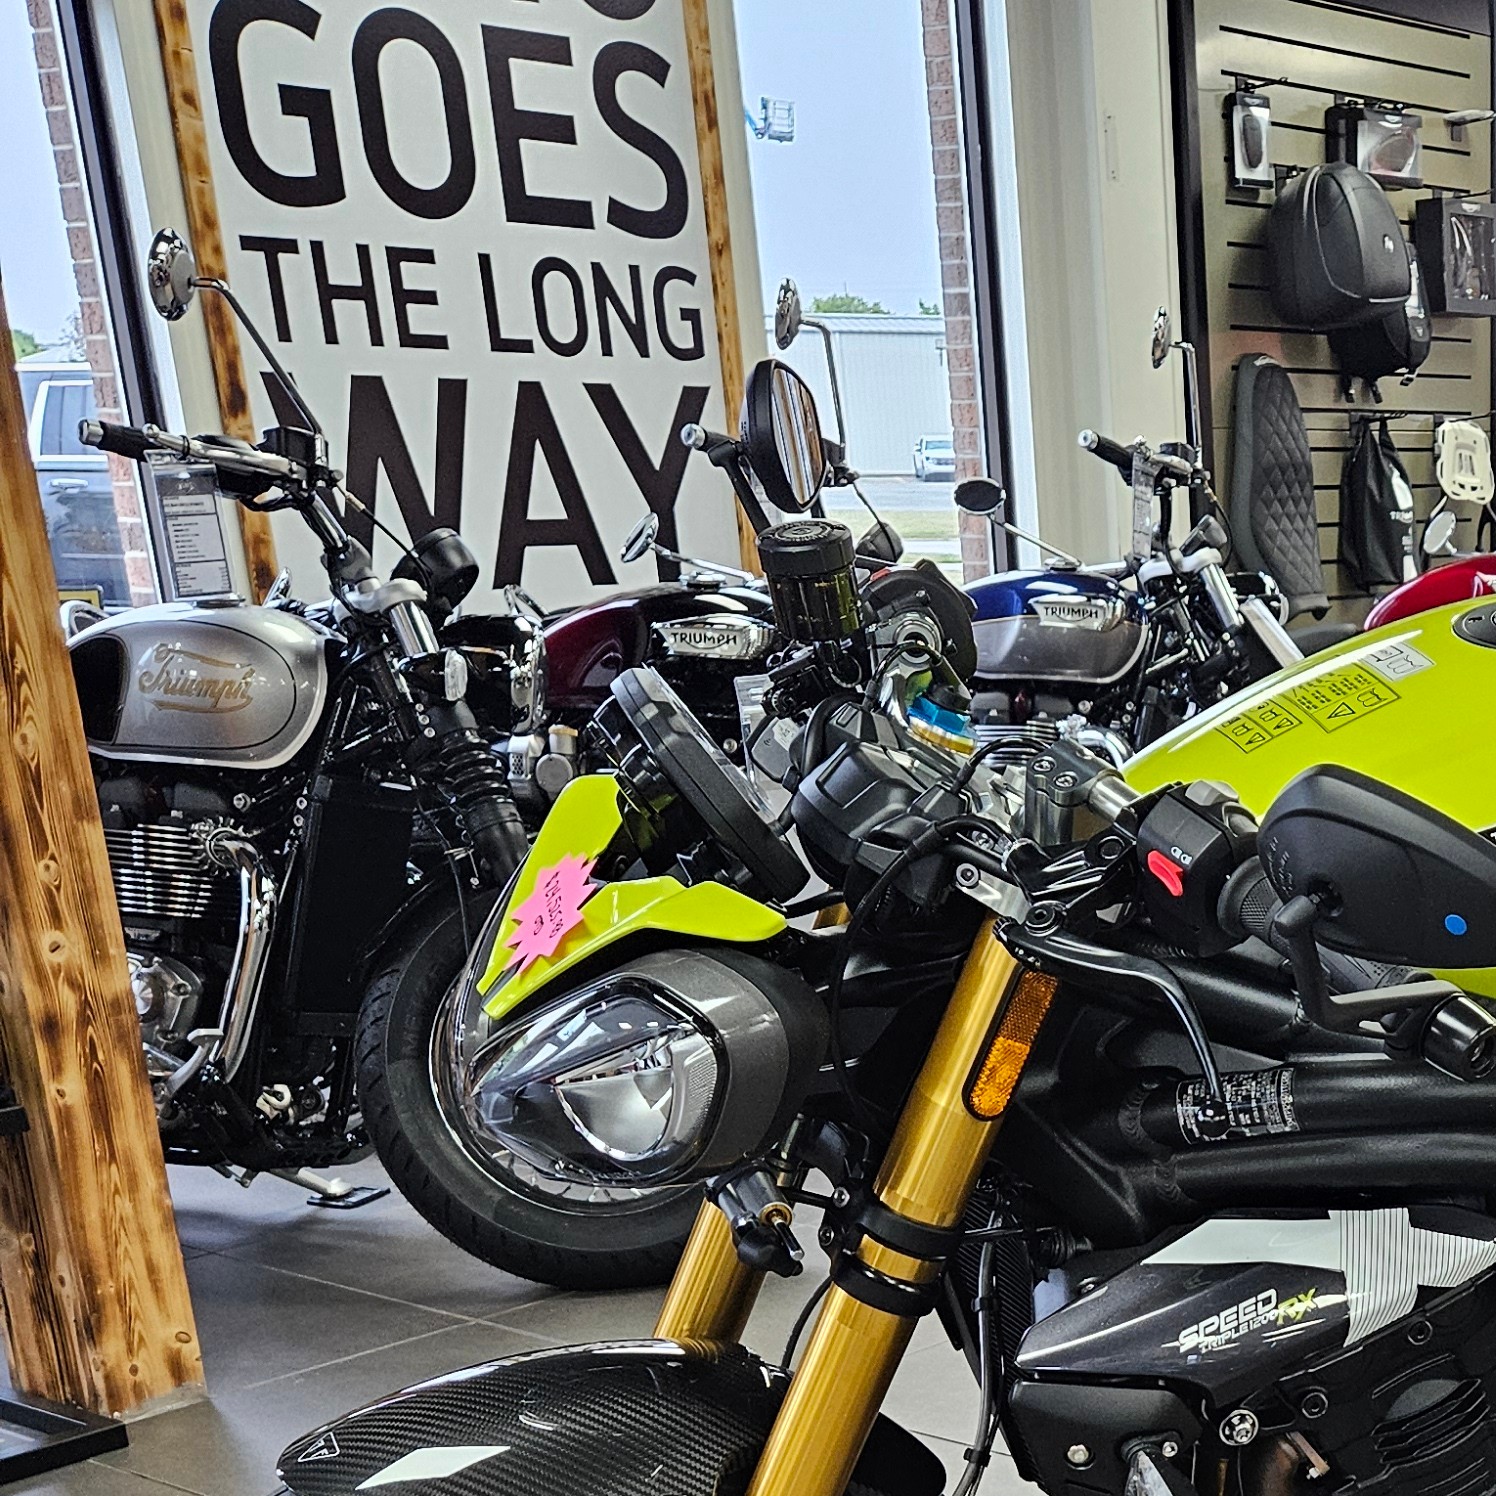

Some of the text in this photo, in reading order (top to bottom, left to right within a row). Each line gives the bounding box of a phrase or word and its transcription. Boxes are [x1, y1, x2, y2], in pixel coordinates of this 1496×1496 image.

[208, 0, 690, 239] GOES
[239, 235, 706, 361] THE LONG
[259, 372, 711, 590] WAY
[670, 632, 738, 649] TRIUMPH
[1043, 606, 1099, 622] TRIUMPH
[138, 643, 255, 713] Triumph
[1179, 1287, 1317, 1353] SPEED RX
[1199, 1308, 1279, 1354] TRIPLE 1200
